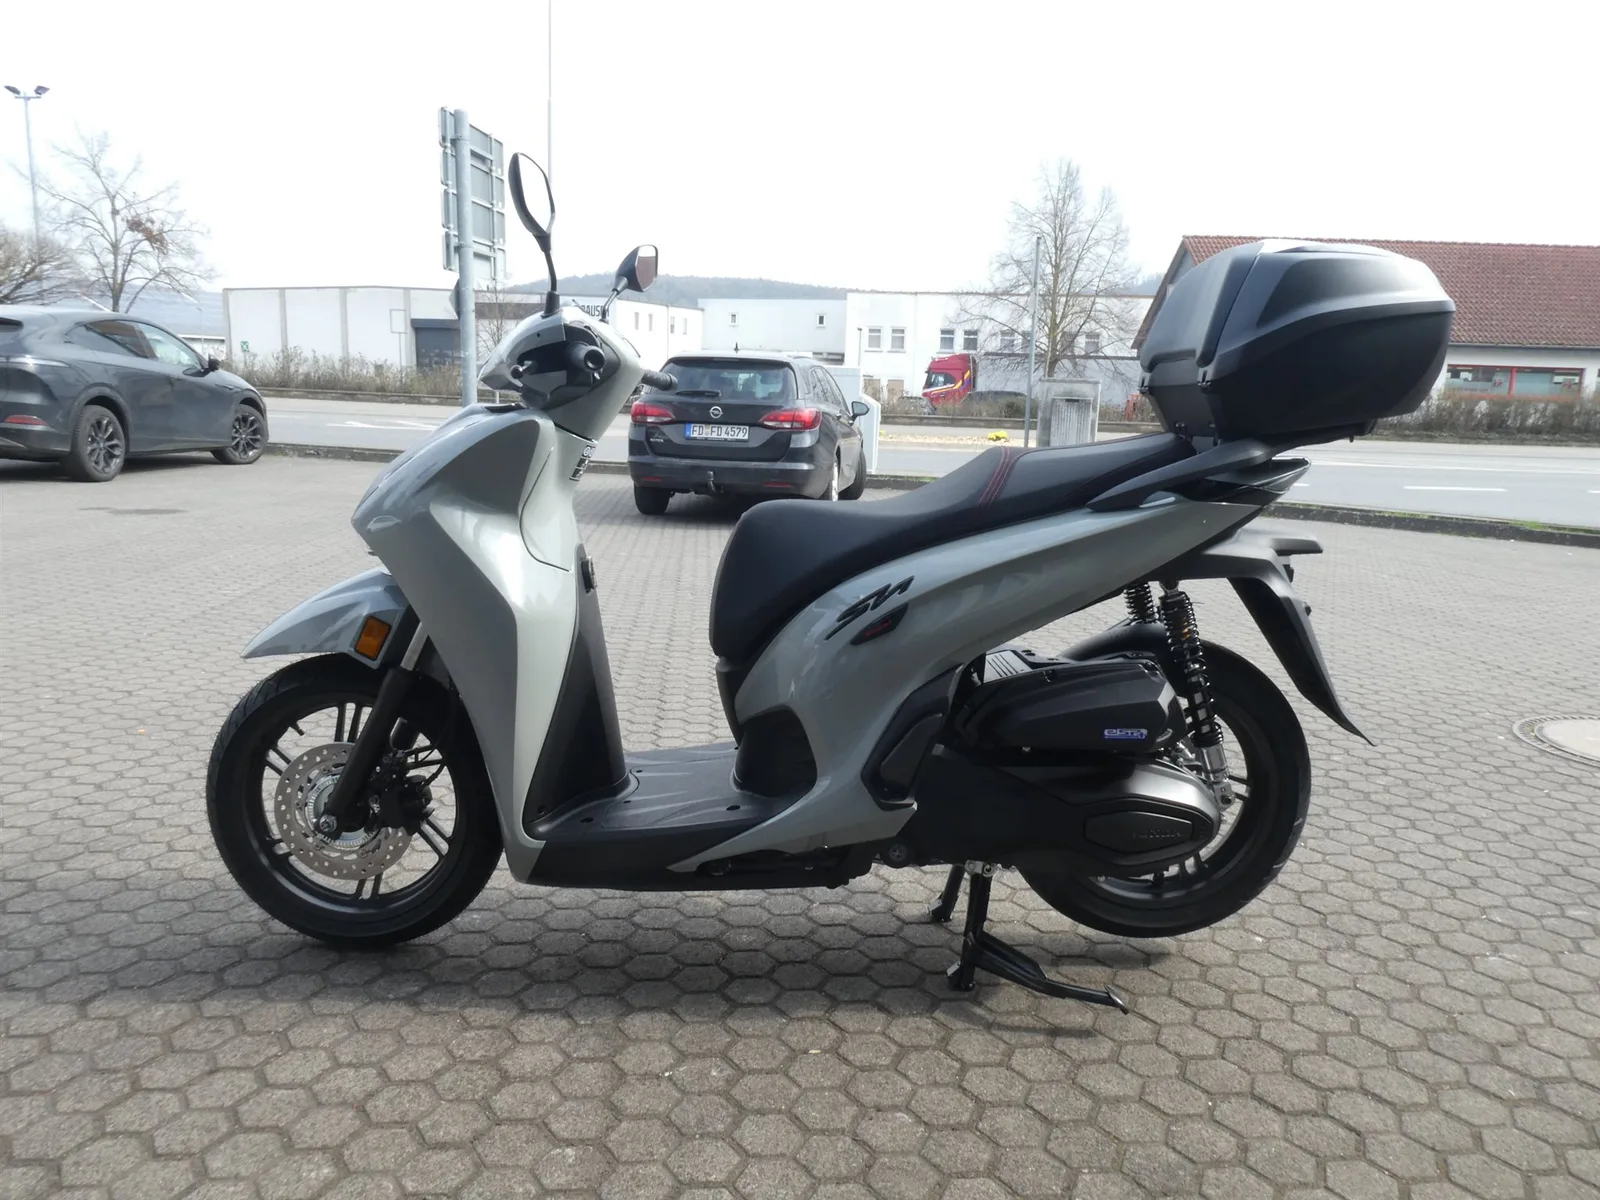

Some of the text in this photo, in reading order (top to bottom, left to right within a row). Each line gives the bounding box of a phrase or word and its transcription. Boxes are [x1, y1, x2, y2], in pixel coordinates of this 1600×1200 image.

[691, 425, 748, 438] FD FD 4579
